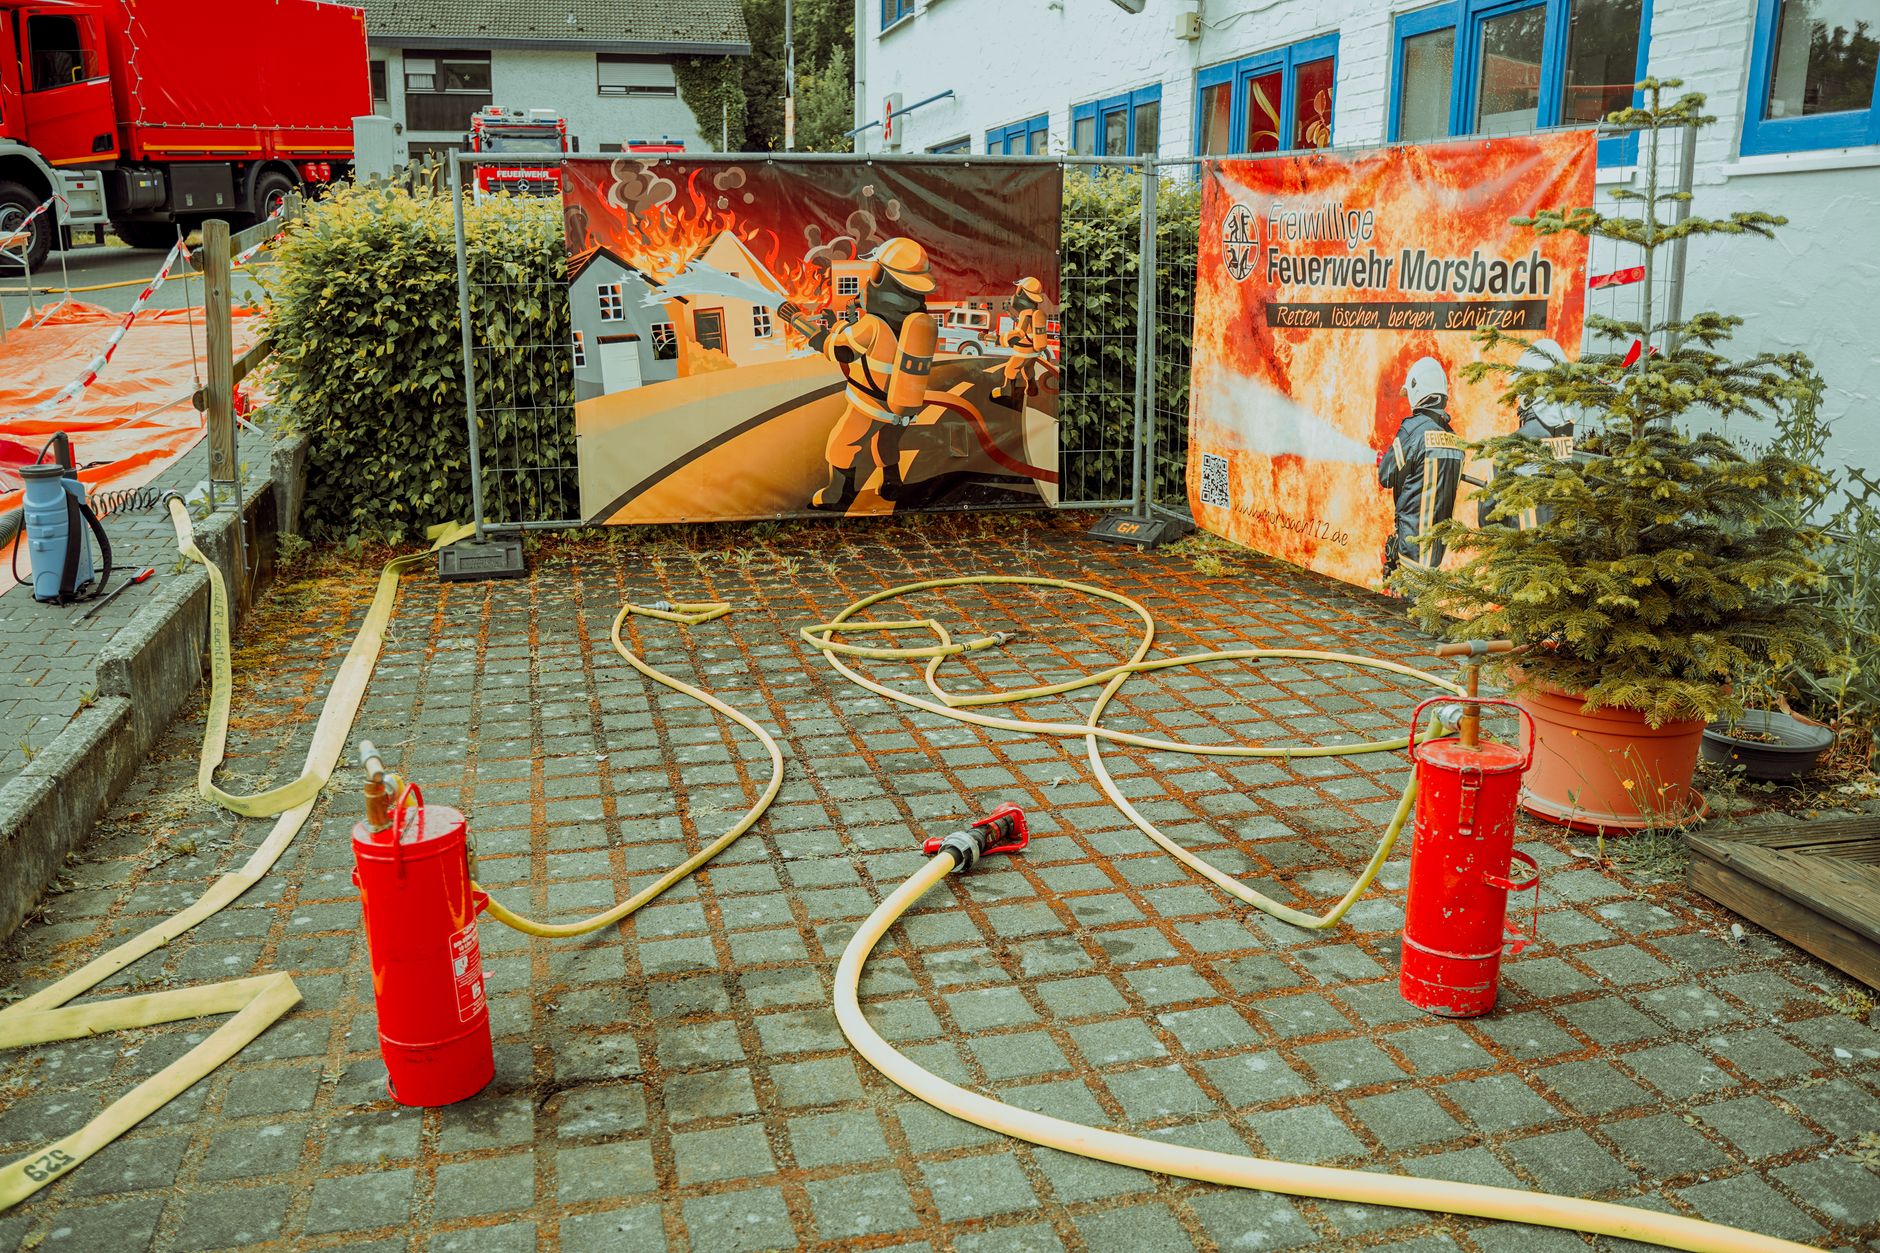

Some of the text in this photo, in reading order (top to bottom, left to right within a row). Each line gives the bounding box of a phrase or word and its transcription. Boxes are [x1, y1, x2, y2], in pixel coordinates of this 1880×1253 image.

[496, 170, 549, 178] FEUERWEHR
[1267, 202, 1374, 250] Freiwillige
[1267, 247, 1551, 295] Feuerwehr Morsbach
[1276, 304, 1526, 330] Retten, löschen, bergen, schützen
[23, 1149, 76, 1182] 529
